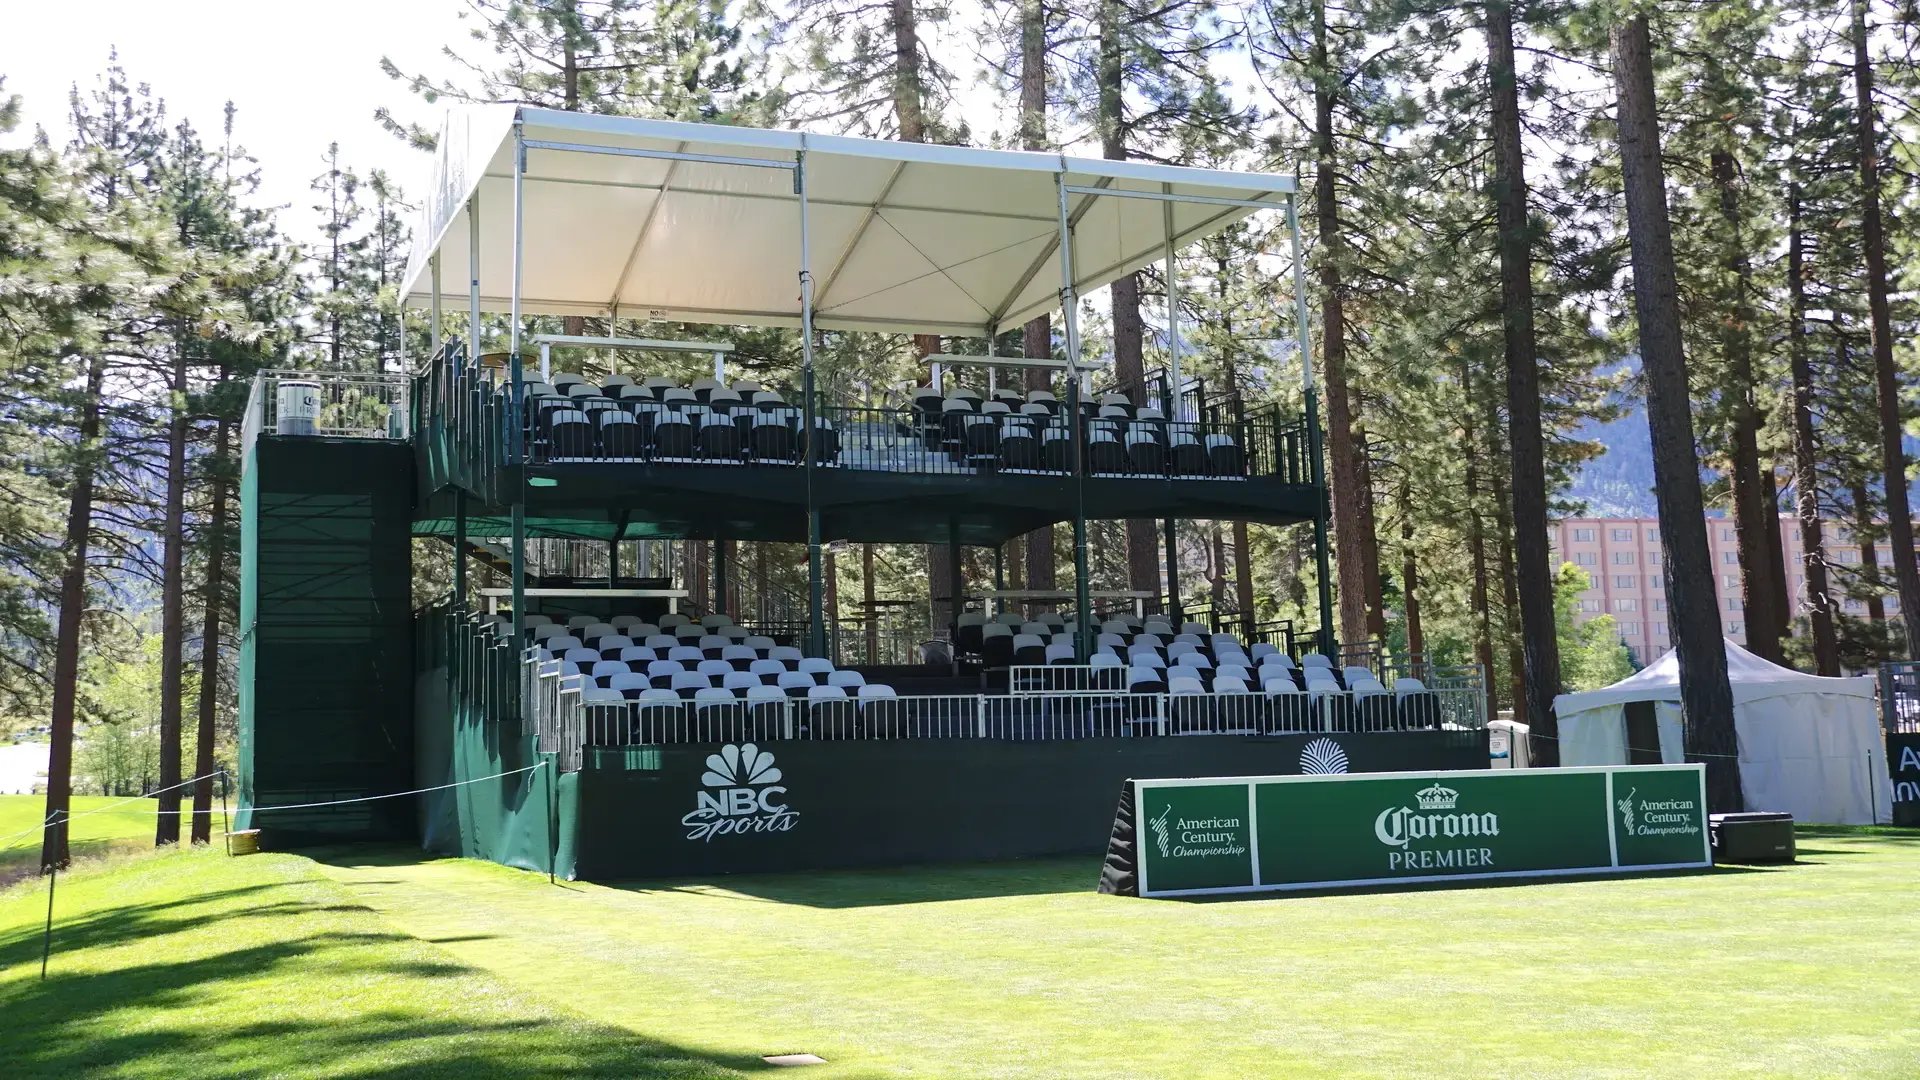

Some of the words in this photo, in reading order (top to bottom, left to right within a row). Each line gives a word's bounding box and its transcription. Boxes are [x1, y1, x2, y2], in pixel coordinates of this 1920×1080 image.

[1900, 746, 1920, 771] A
[697, 786, 788, 817] NBC
[1641, 799, 1693, 811] American
[681, 807, 800, 843] Sports
[1176, 817, 1240, 830] American
[1375, 806, 1500, 850] Corona
[1637, 824, 1699, 836] Championship
[1173, 844, 1245, 859] Championship
[1389, 848, 1494, 870] PREMIER
